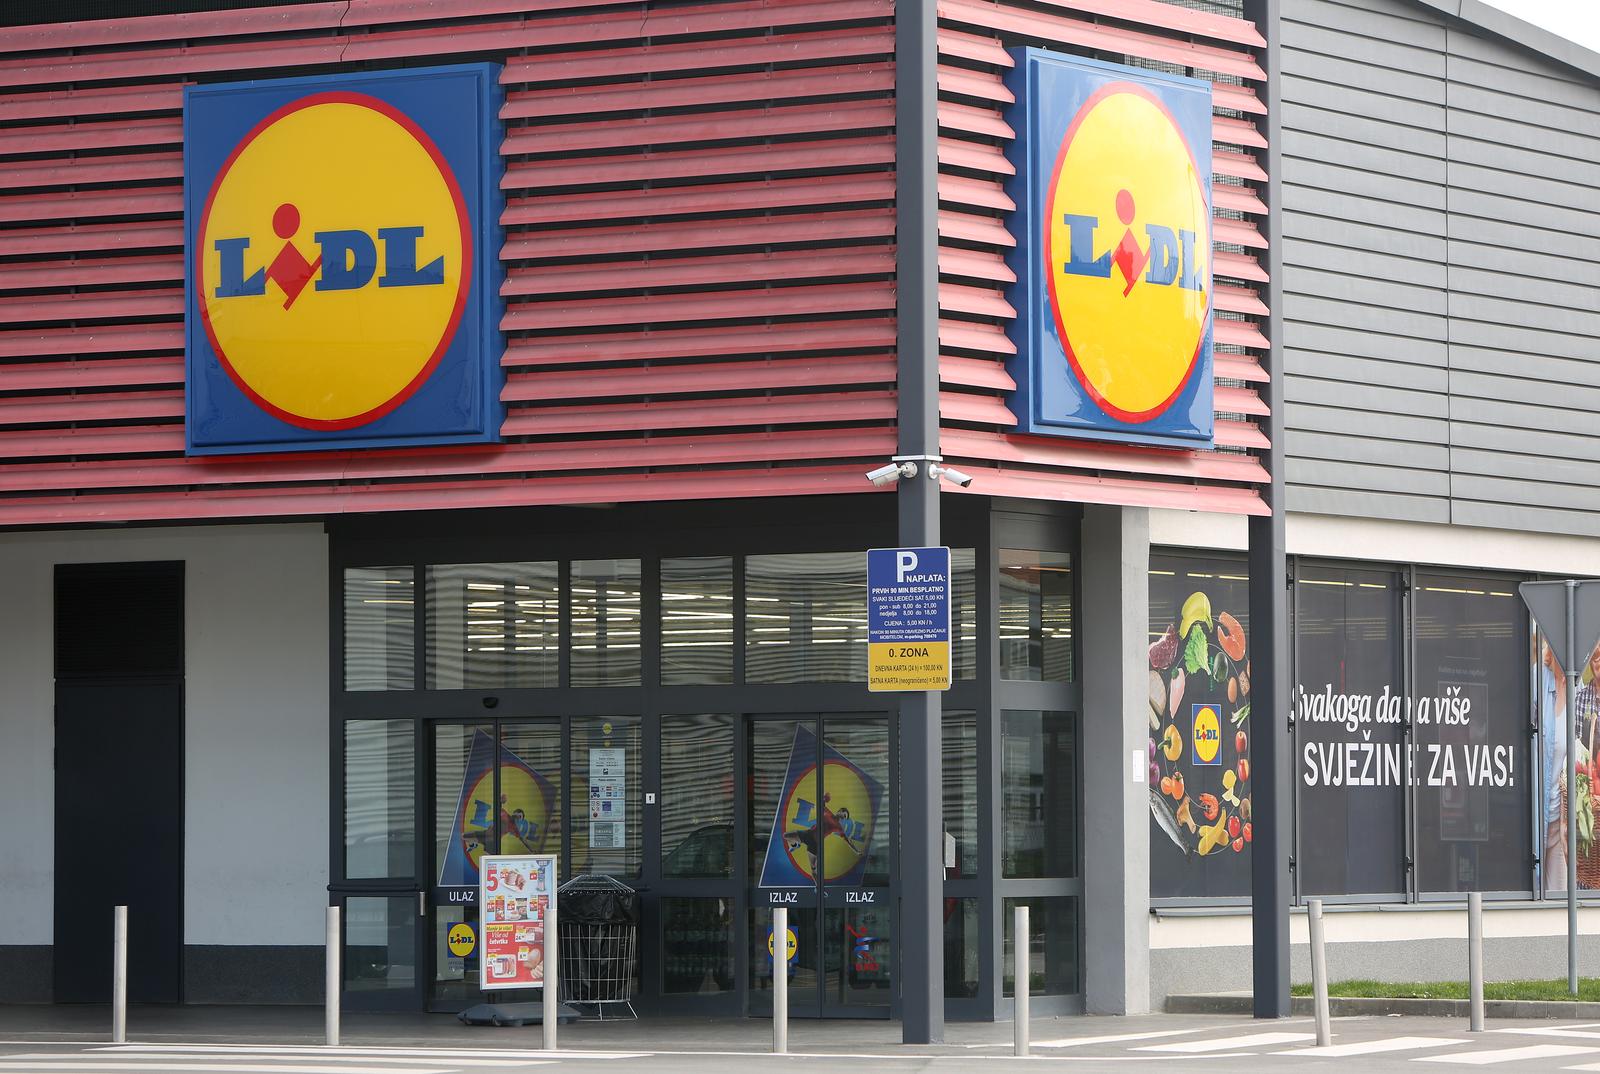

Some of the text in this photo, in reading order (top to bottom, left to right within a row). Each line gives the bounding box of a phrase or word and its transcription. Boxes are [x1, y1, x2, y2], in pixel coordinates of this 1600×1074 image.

[896, 551, 918, 583] P
[906, 574, 946, 583] NAPLATA:
[872, 587, 890, 595] PRVIH
[910, 585, 944, 593] BESPLATNO
[888, 647, 929, 658] 0. ZONA
[1434, 686, 1471, 725] više
[1427, 744, 1457, 786] ZA
[1463, 744, 1514, 787] VAS!
[487, 869, 498, 891] 5
[449, 891, 474, 902] ULAZ
[769, 892, 798, 903] IZLAZ
[846, 892, 874, 903] IZLAZ
